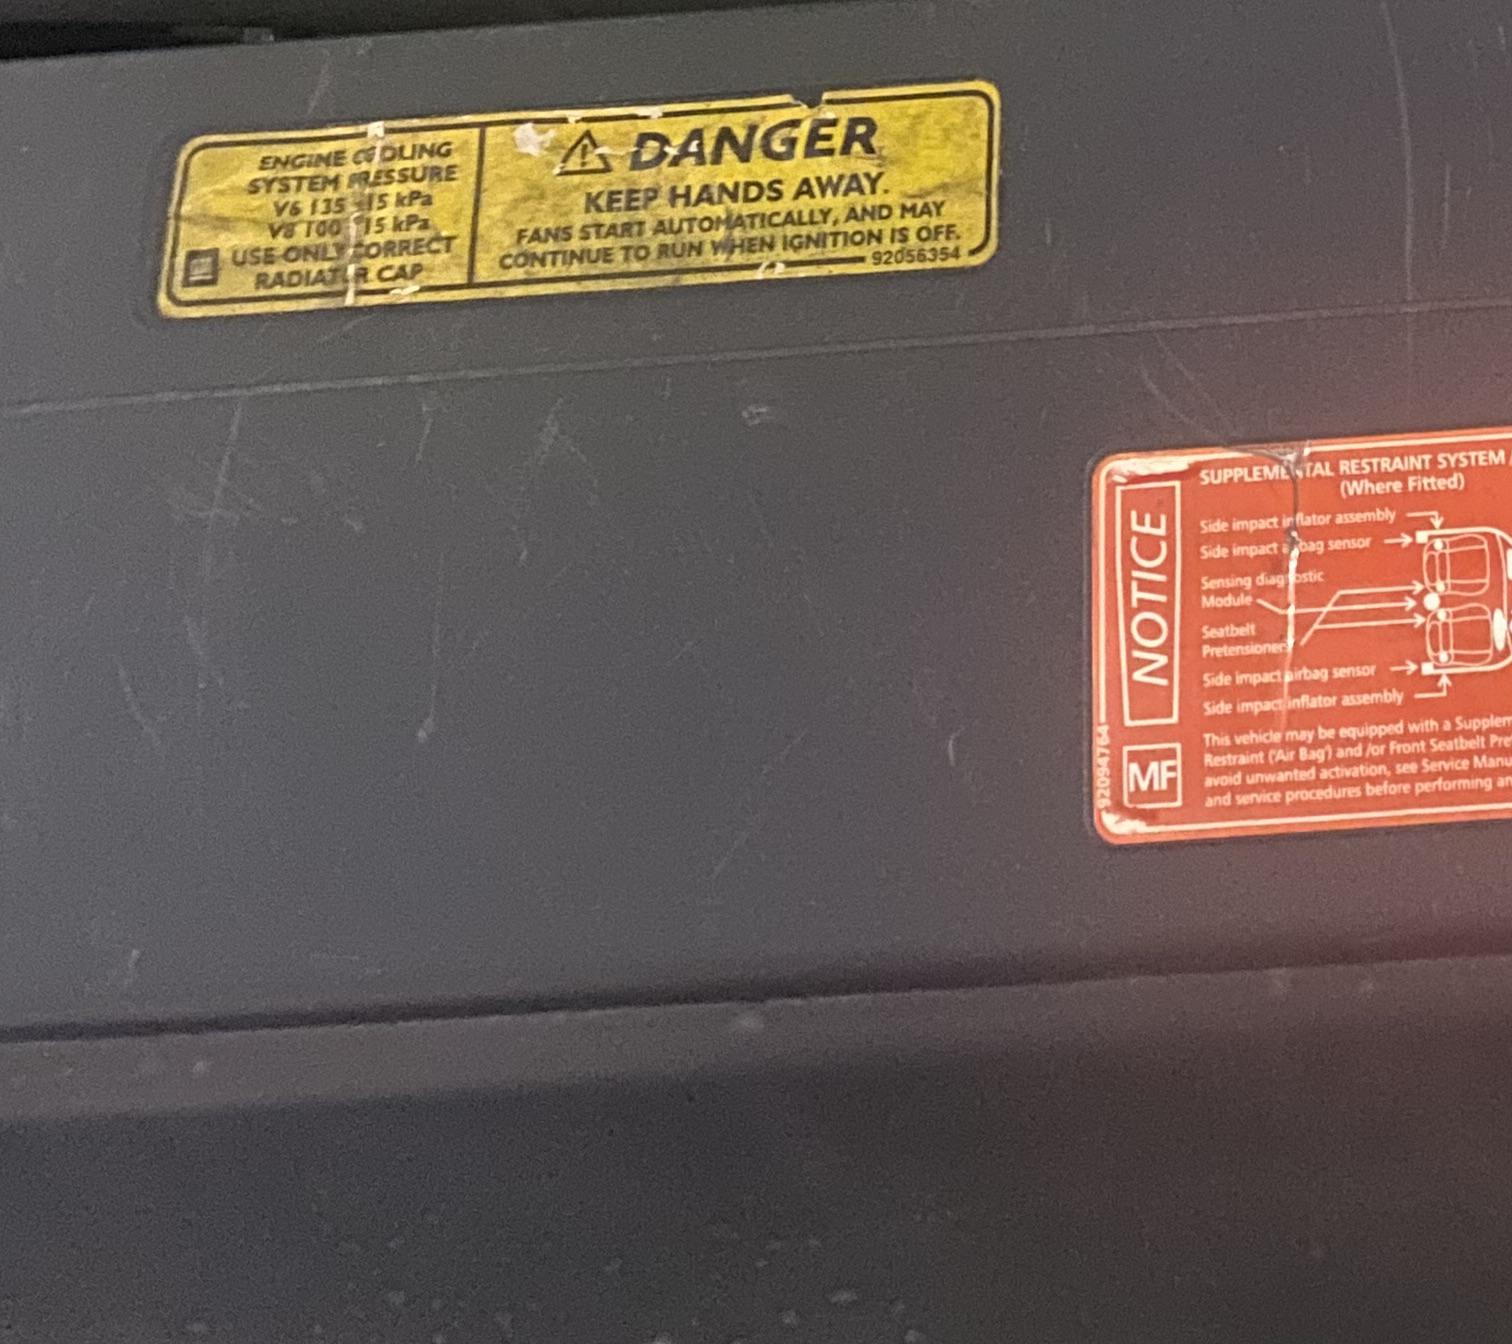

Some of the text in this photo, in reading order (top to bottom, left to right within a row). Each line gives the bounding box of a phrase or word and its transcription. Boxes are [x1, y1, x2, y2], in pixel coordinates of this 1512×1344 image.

[630, 116, 876, 170] DANGER
[258, 149, 346, 171] ENGINE
[246, 164, 457, 195] SYSTEM PRESSURE
[584, 171, 888, 213] KEEP HANDS AWAY.
[310, 196, 347, 215] 135
[394, 189, 433, 207] kPa
[305, 217, 343, 237] 100
[391, 213, 431, 232] kPa
[515, 199, 945, 245] FANS START AUTOMATICALLY, AND MAY
[231, 246, 275, 267] USE
[280, 240, 347, 263] ONLY
[498, 222, 960, 270] CONTINUE TO RUN WHEN IGNITION IS OFF.
[375, 262, 424, 282] CAP
[1338, 454, 1430, 474] RESTRAINT
[1437, 449, 1505, 468] SYSTEM
[1340, 472, 1464, 497] (Where Fitted)
[1199, 518, 1229, 533] Side
[1231, 516, 1278, 532] impact
[1334, 507, 1396, 524] assembly
[1199, 537, 1371, 559] Side impact sensor
[1200, 576, 1253, 590] Sensing
[1130, 511, 1168, 685] NOTICE
[1201, 593, 1252, 607] Module
[1201, 623, 1255, 638] Seatbelt
[1202, 671, 1232, 687] Side
[1235, 669, 1282, 686] impact
[1331, 664, 1376, 678] sensor
[1202, 688, 1403, 715] Side impact inflator assembly
[1202, 732, 1231, 747] This
[1234, 729, 1282, 744] vehicle
[1284, 729, 1315, 744] may
[1316, 725, 1336, 739] be
[1338, 720, 1404, 739] equipped
[1407, 718, 1439, 733] with
[1441, 719, 1452, 731] a
[1126, 759, 1178, 791] MF
[1203, 791, 1231, 807] and
[1234, 791, 1280, 805] service
[1284, 785, 1361, 804] procedures
[1364, 780, 1411, 796] before
[1414, 776, 1493, 795] performing
